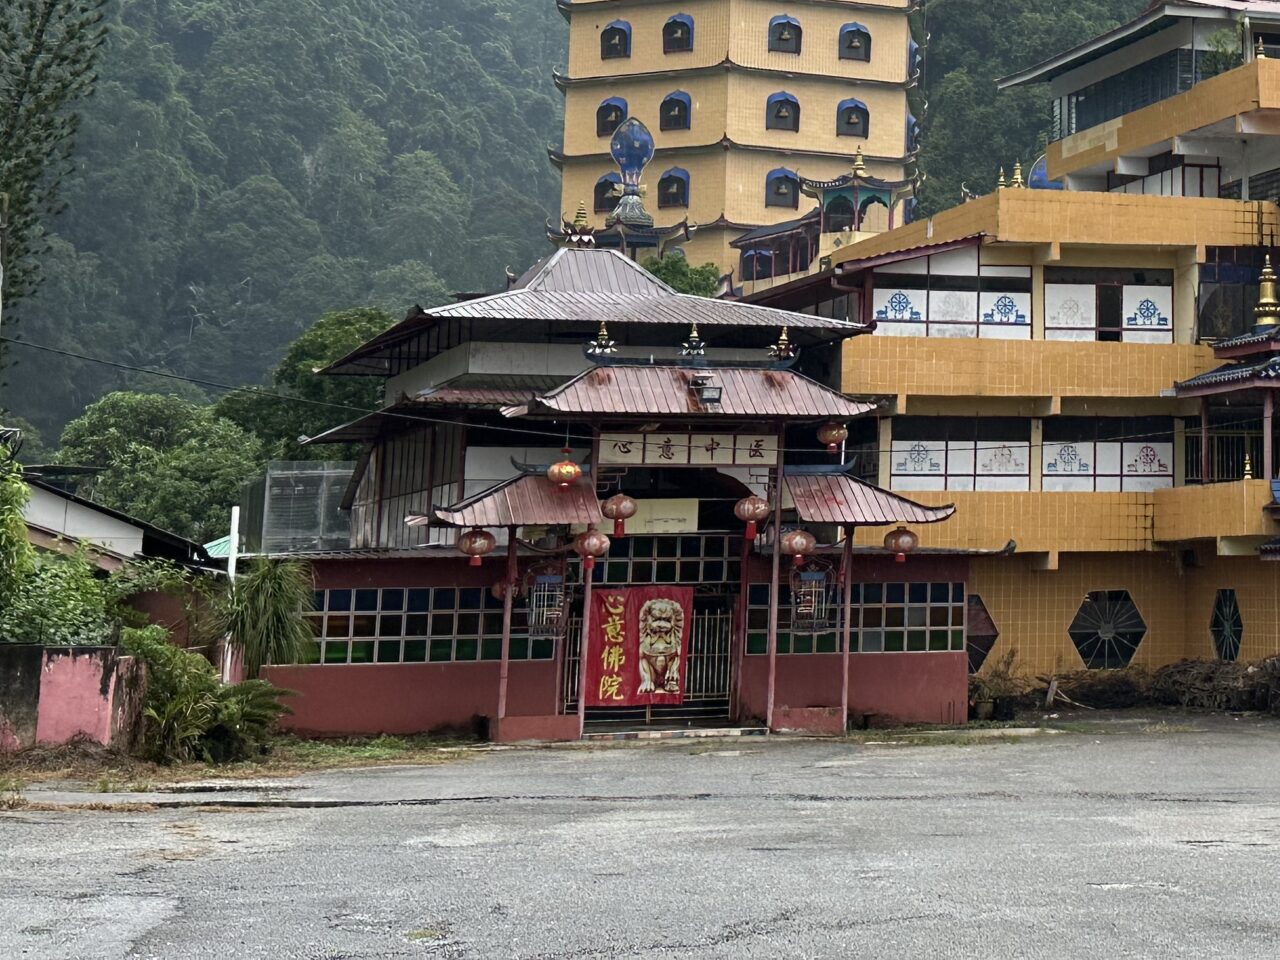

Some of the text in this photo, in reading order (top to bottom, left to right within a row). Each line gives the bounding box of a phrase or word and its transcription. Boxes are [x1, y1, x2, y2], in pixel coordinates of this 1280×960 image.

[613, 437, 764, 461] 心意中医
[599, 594, 626, 701] 心意佛院
